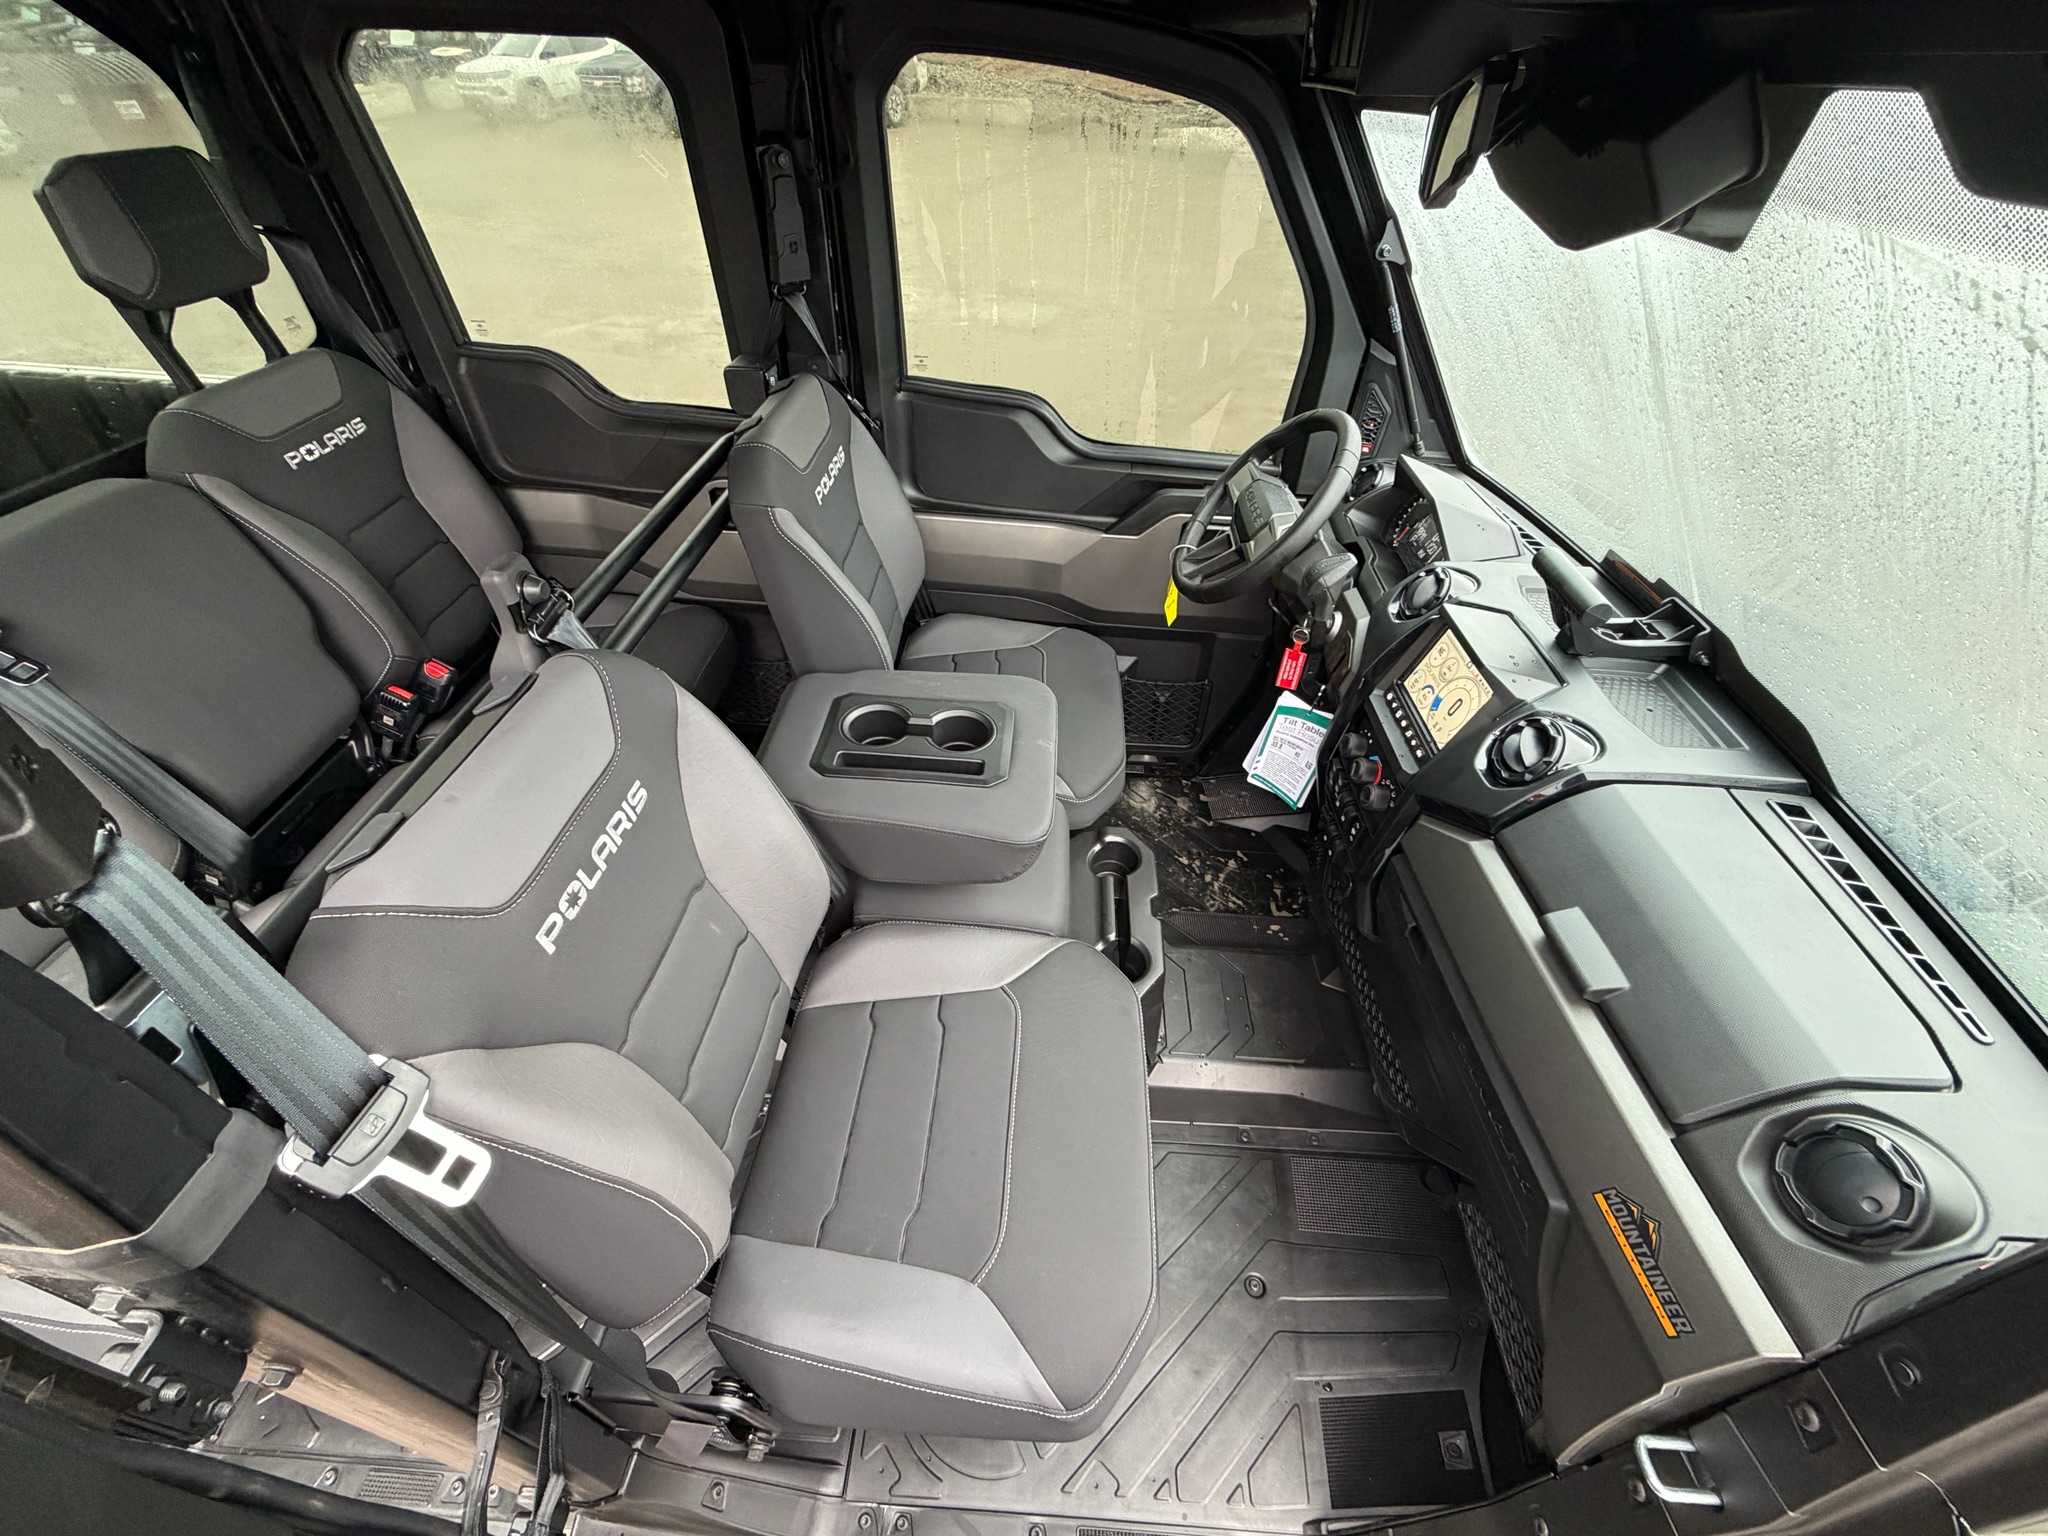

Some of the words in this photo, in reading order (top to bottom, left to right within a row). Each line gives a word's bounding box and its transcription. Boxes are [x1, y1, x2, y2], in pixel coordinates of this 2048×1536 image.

[283, 416, 367, 470] POLARIS
[815, 445, 845, 506] POLARIS
[1278, 723, 1296, 734] Test
[1298, 729, 1319, 745] Resu
[1283, 717, 1298, 727] Tilt
[1301, 721, 1325, 738] Table
[535, 779, 648, 956] POLARIS
[1602, 1188, 1694, 1333] MOUNTAINEER
